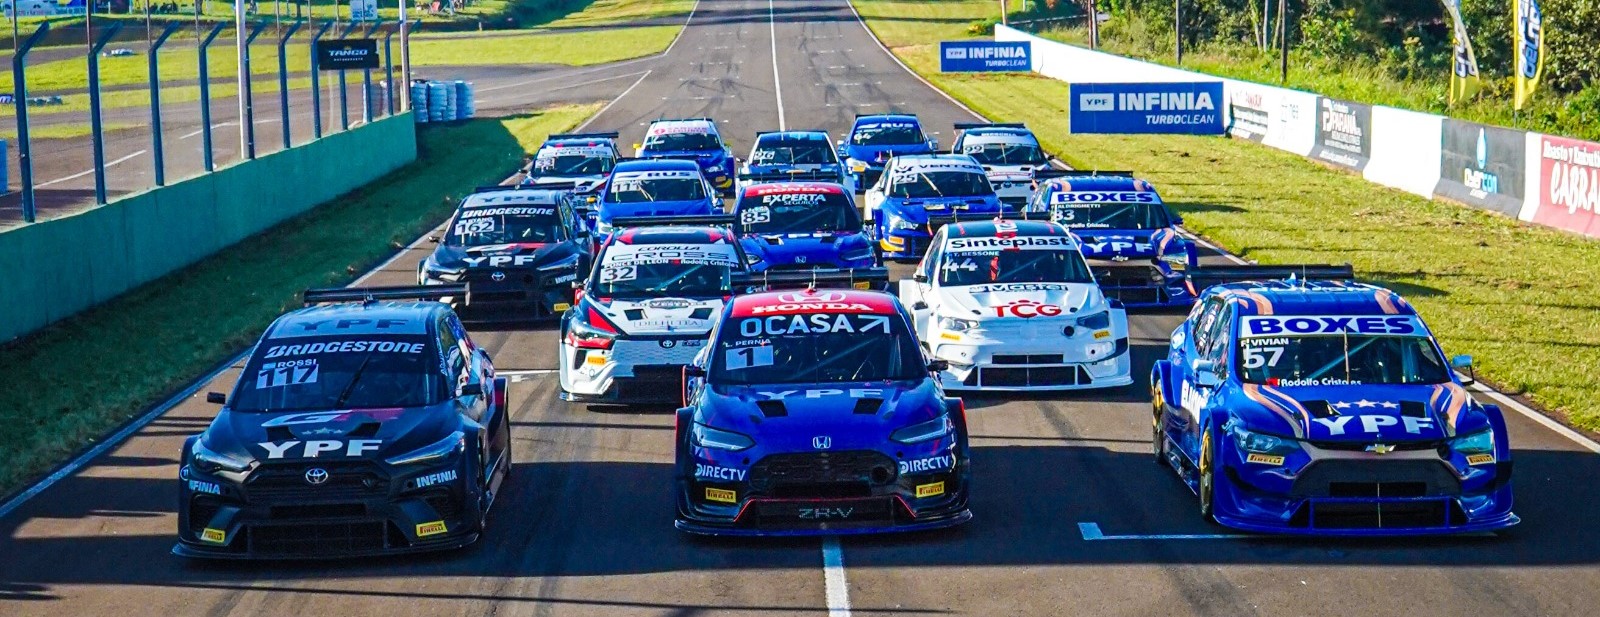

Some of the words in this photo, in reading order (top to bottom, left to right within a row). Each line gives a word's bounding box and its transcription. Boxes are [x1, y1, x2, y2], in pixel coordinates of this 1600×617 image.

[968, 46, 1027, 58] INFINIA
[1086, 98, 1108, 106] YPF
[1119, 92, 1215, 111] INFINIA
[1146, 114, 1215, 125] TURBOCLEAN
[897, 174, 916, 183] 25
[763, 194, 826, 206] EXPERTA
[1057, 193, 1153, 203] BOXES
[461, 207, 555, 218] BRIDGESTONE
[744, 212, 768, 223] 85
[457, 221, 493, 234] 162
[951, 237, 1070, 250] Sinteplast
[1084, 241, 1153, 253] YPF
[462, 255, 536, 267] YPF
[612, 251, 730, 261] CROSS
[942, 257, 978, 271] 44
[604, 266, 634, 281] 32
[752, 302, 874, 315] HONDA
[990, 303, 1062, 318] TCG
[298, 318, 408, 331] YPF
[740, 314, 854, 337] OCASA
[1250, 316, 1415, 335] BOXES
[1250, 338, 1289, 346] VIVIAN
[264, 340, 425, 358] BRIDGESTONE
[277, 358, 317, 368] ROSSI
[738, 348, 754, 367] 1
[1242, 347, 1285, 369] 57
[259, 363, 319, 388] 117
[1281, 377, 1319, 387] Rodolfo
[756, 389, 884, 399] YPF
[1312, 415, 1434, 435] YPF
[258, 439, 382, 459] YPF
[899, 455, 949, 474] DIRECTV
[1249, 454, 1282, 464] PIRELLI
[416, 469, 457, 488] INFINIA
[695, 463, 746, 481] DIRECTV
[799, 507, 853, 518] ZR-V
